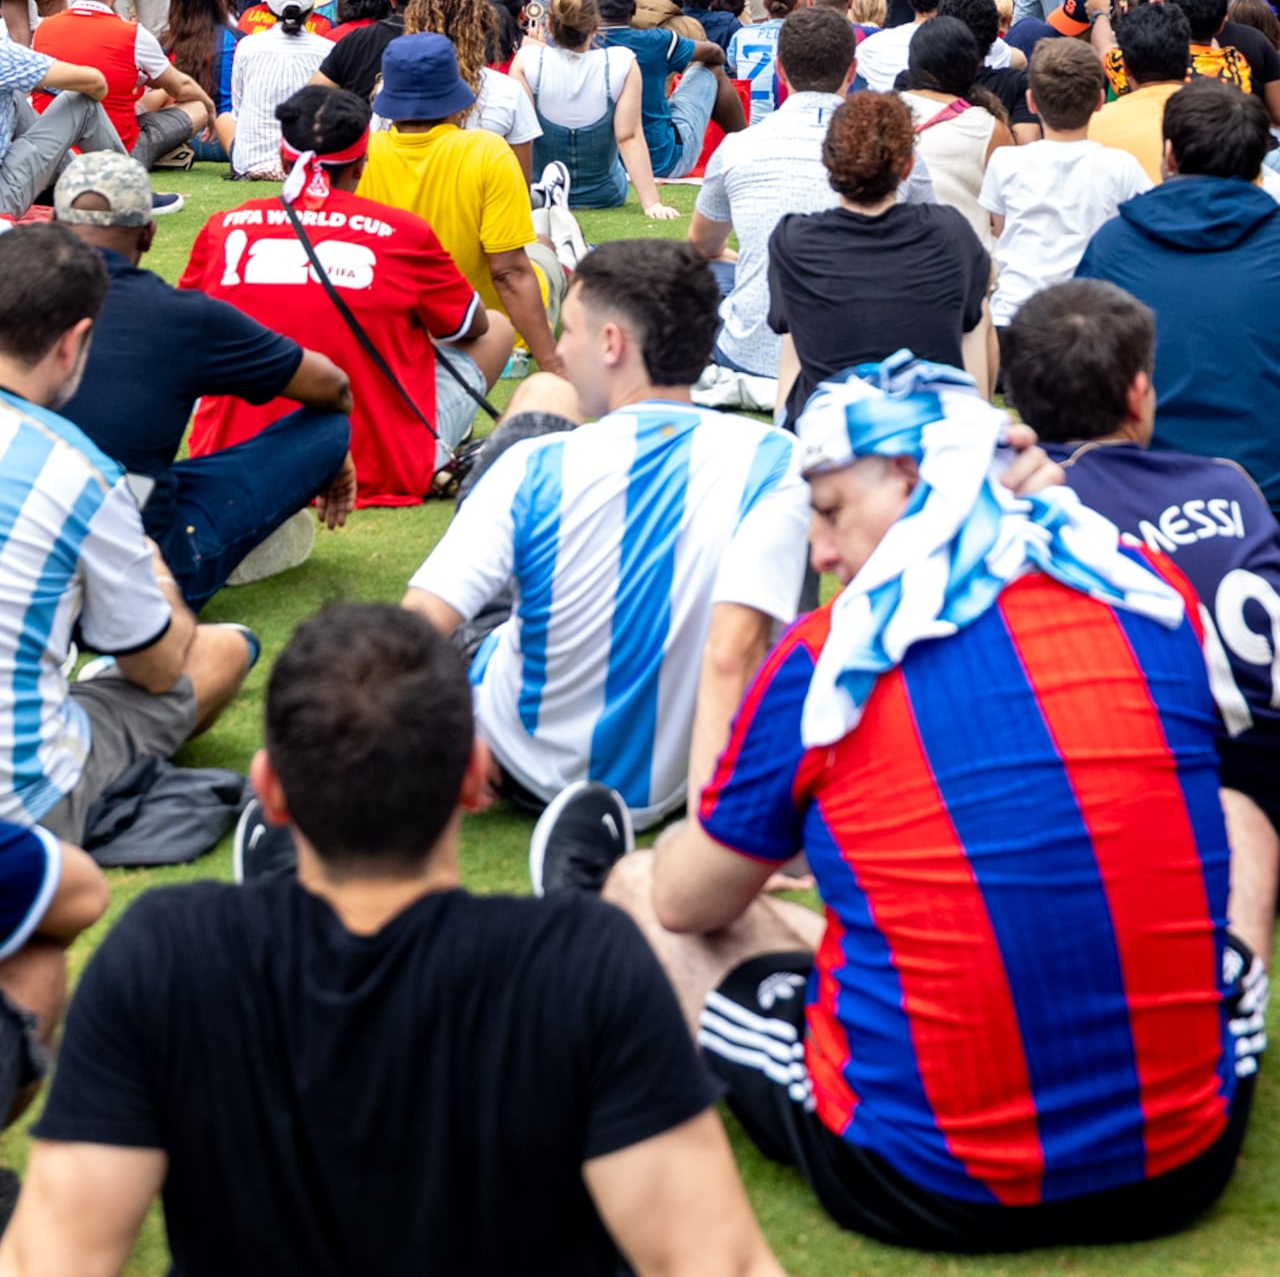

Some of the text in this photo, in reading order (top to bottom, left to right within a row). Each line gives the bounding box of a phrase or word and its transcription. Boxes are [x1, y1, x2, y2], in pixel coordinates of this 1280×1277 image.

[223, 209, 263, 227] FIFA
[348, 214, 393, 237] CUP
[327, 266, 356, 279] FIFA
